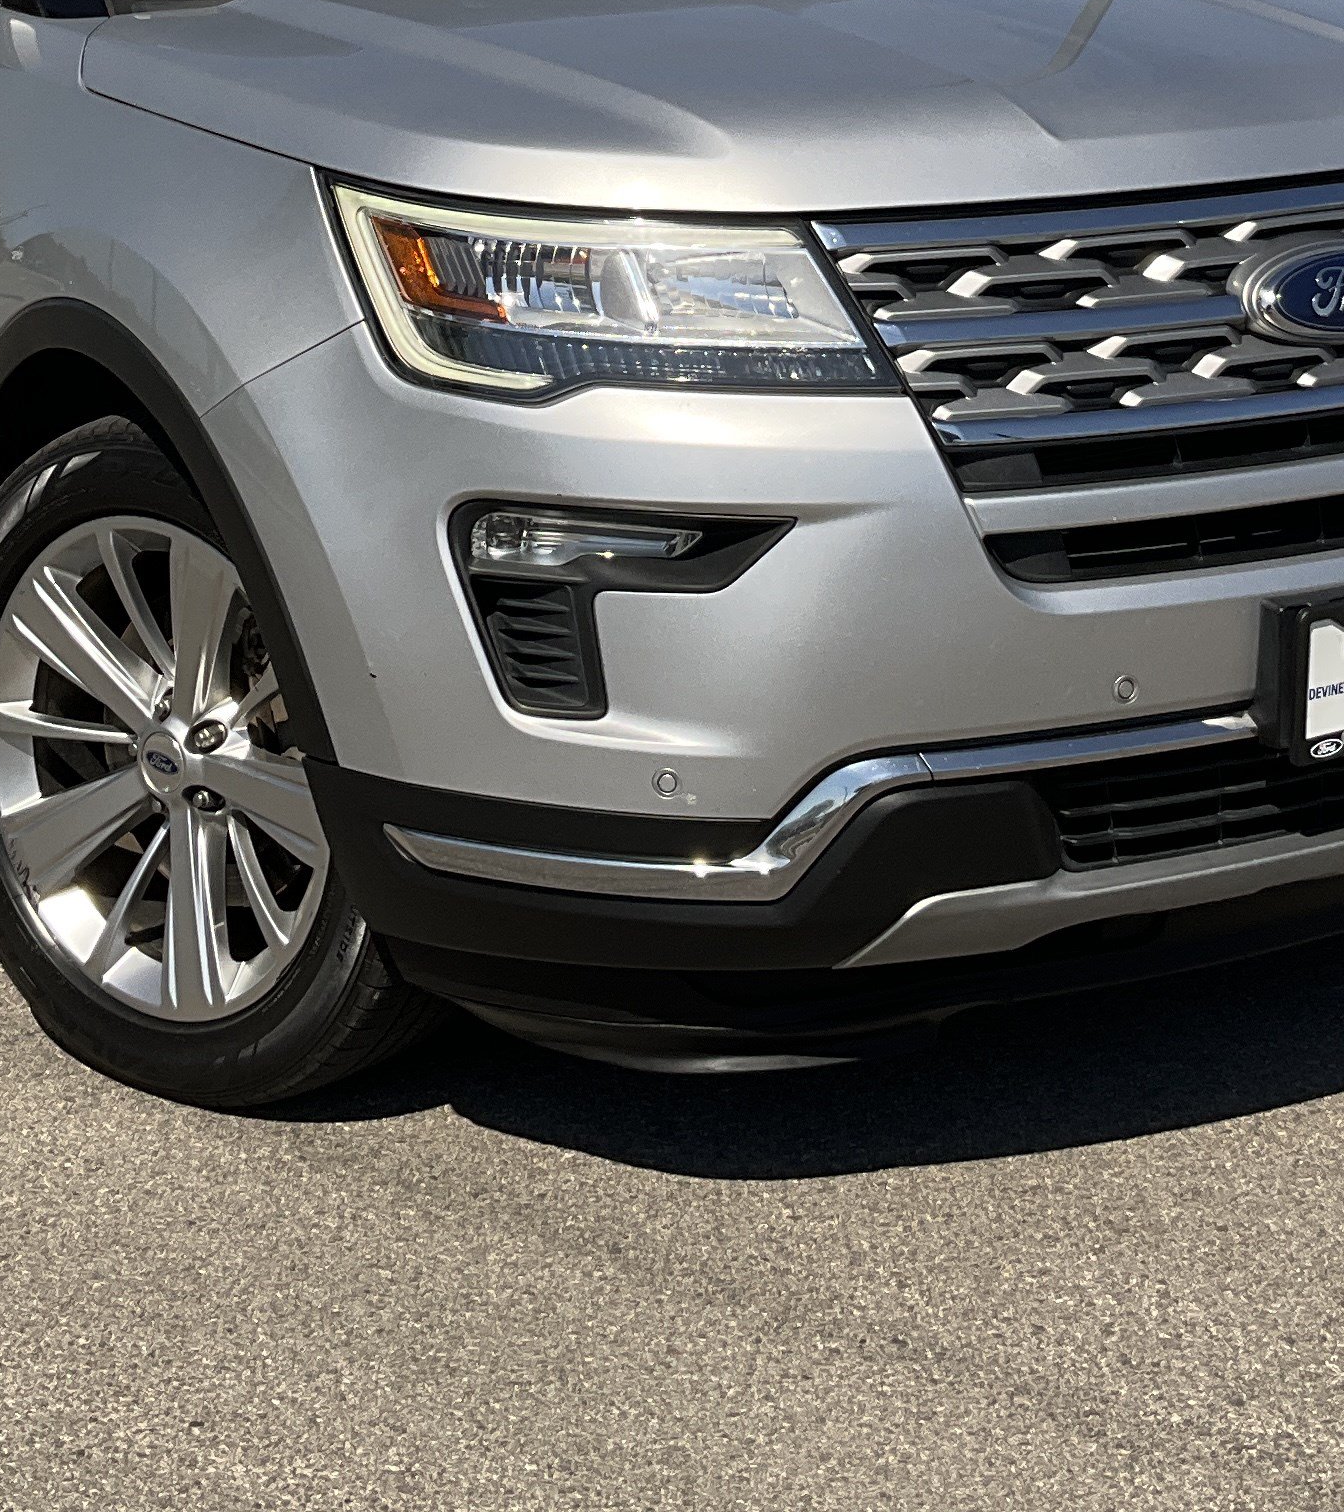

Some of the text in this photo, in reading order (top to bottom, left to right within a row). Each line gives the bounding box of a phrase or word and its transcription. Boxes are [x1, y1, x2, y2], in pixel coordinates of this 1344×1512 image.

[1308, 682, 1344, 701] DEVINE
[1316, 741, 1337, 755] Ford
[149, 752, 173, 772] Ford
